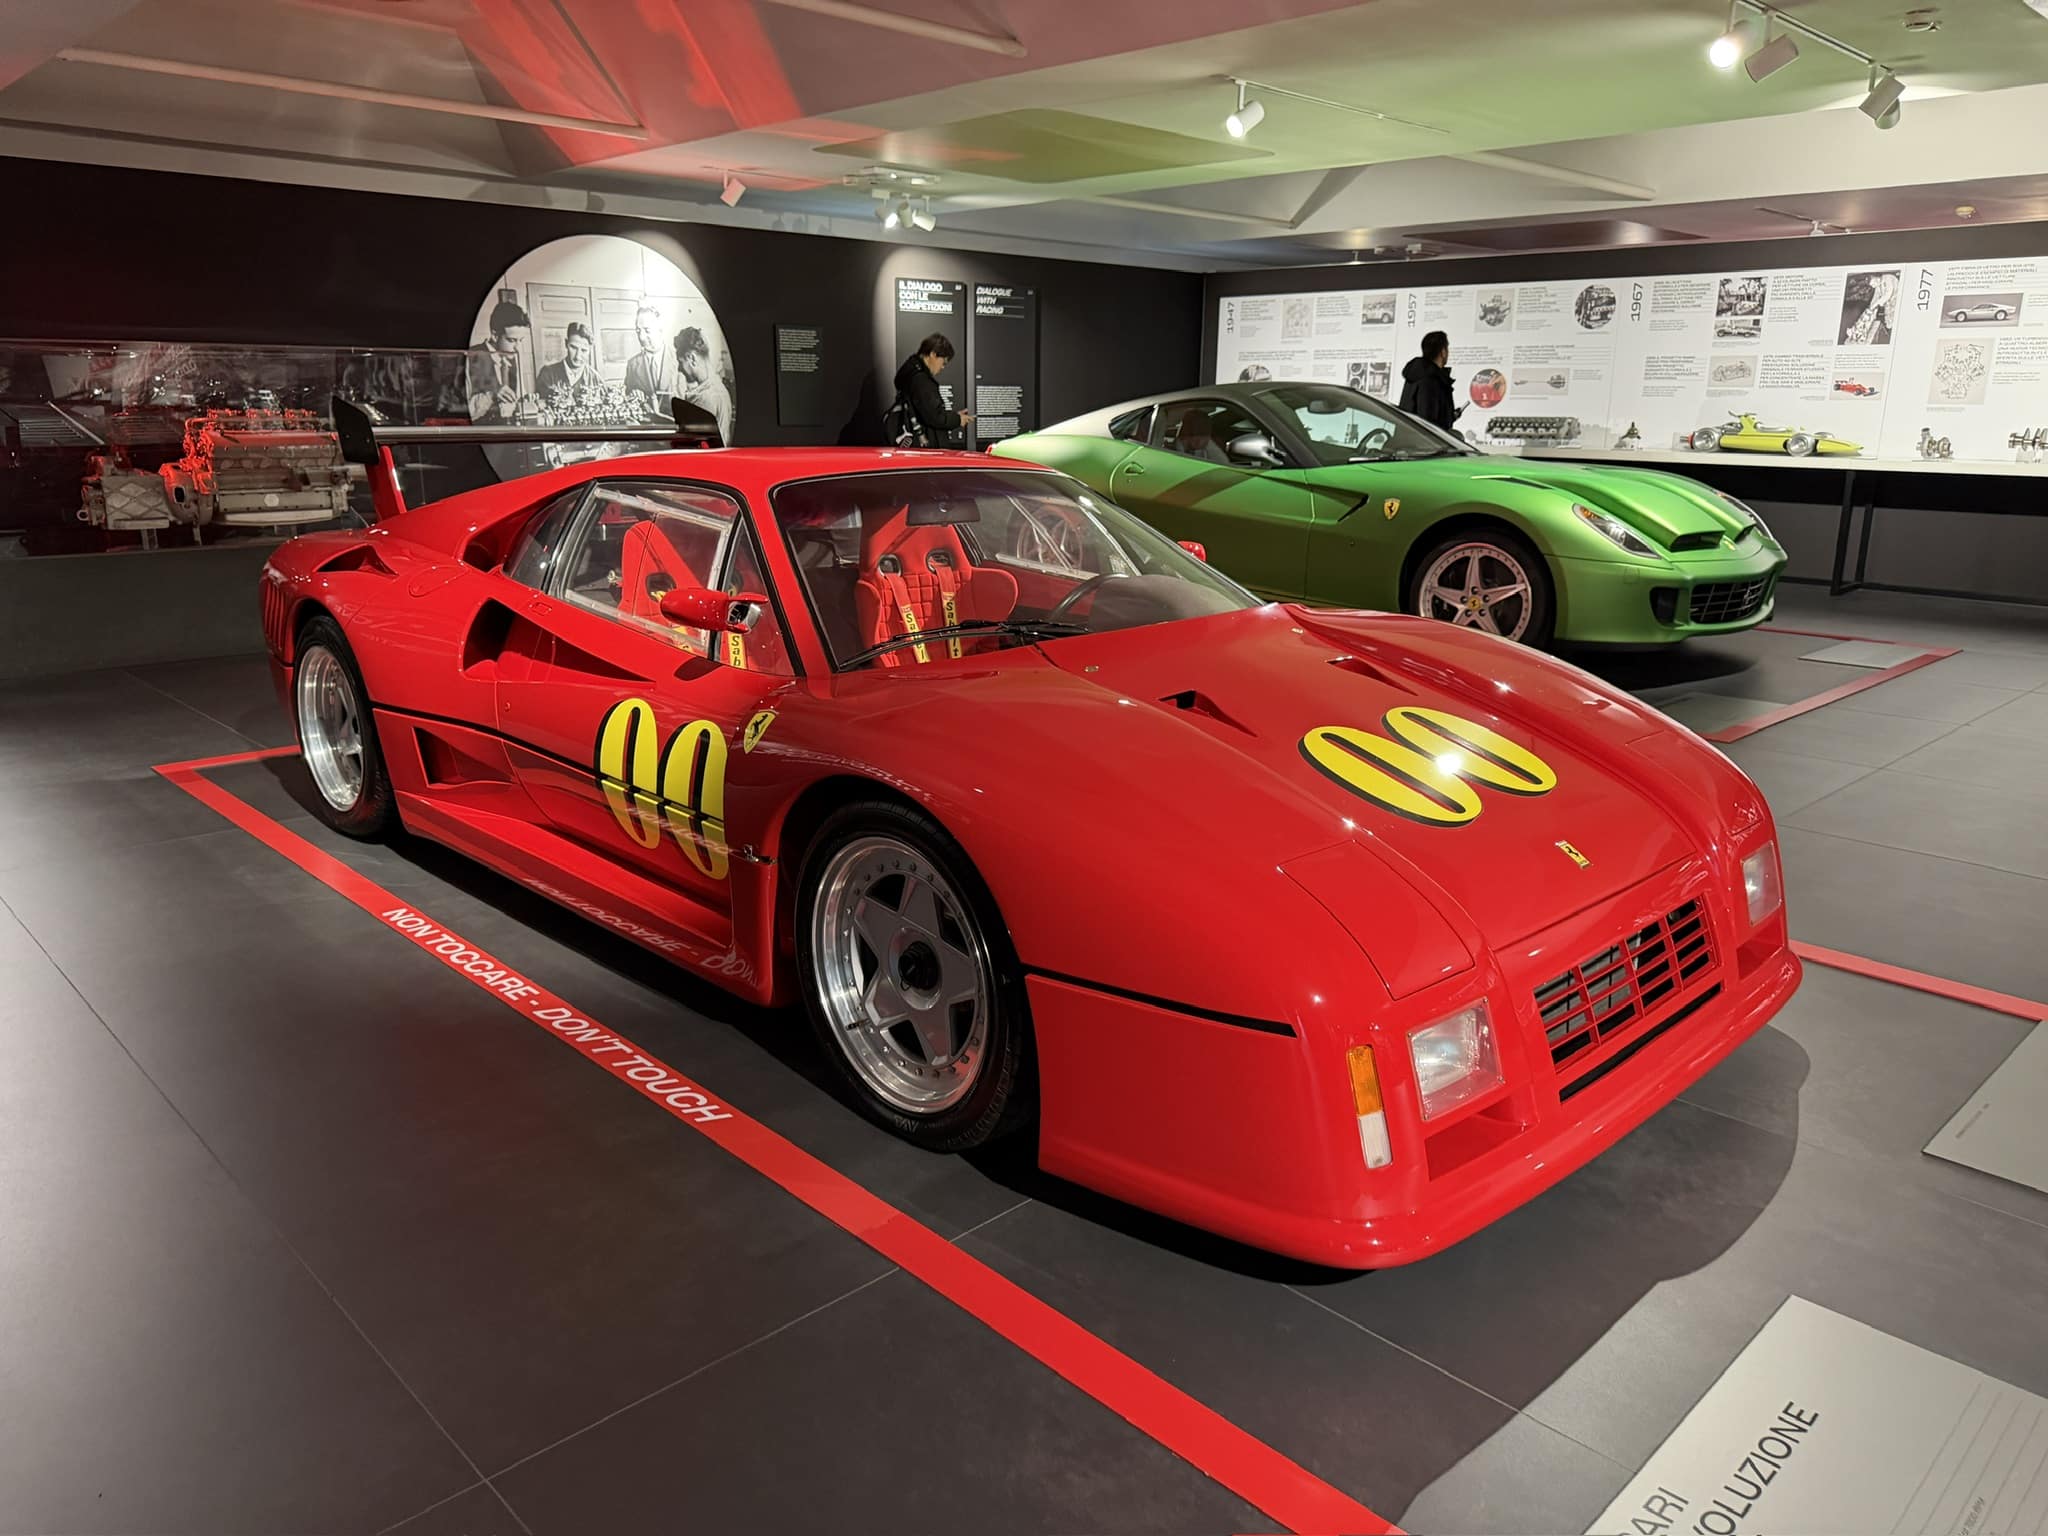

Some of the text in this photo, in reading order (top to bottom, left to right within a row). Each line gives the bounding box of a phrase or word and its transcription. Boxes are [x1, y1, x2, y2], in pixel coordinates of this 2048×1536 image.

[899, 280, 908, 290] IL
[907, 281, 943, 292] DIALOGO
[899, 291, 928, 301] CON LE
[976, 287, 1012, 296] DIALOGUE
[976, 296, 997, 305] WITH
[1631, 283, 1644, 322] 1967
[1917, 269, 1934, 311] 1977
[976, 306, 1004, 315] RACING
[1226, 301, 1235, 335] 1947
[1408, 293, 1417, 328] 1957
[946, 602, 959, 657] Sablt
[1298, 706, 1558, 827] 00
[594, 697, 728, 880] 00
[382, 907, 434, 938] NON
[426, 933, 539, 1002] TOCCARE
[533, 1007, 633, 1054] DON'T
[612, 1054, 733, 1123] TOUCH
[1616, 1486, 1690, 1536] ARI
